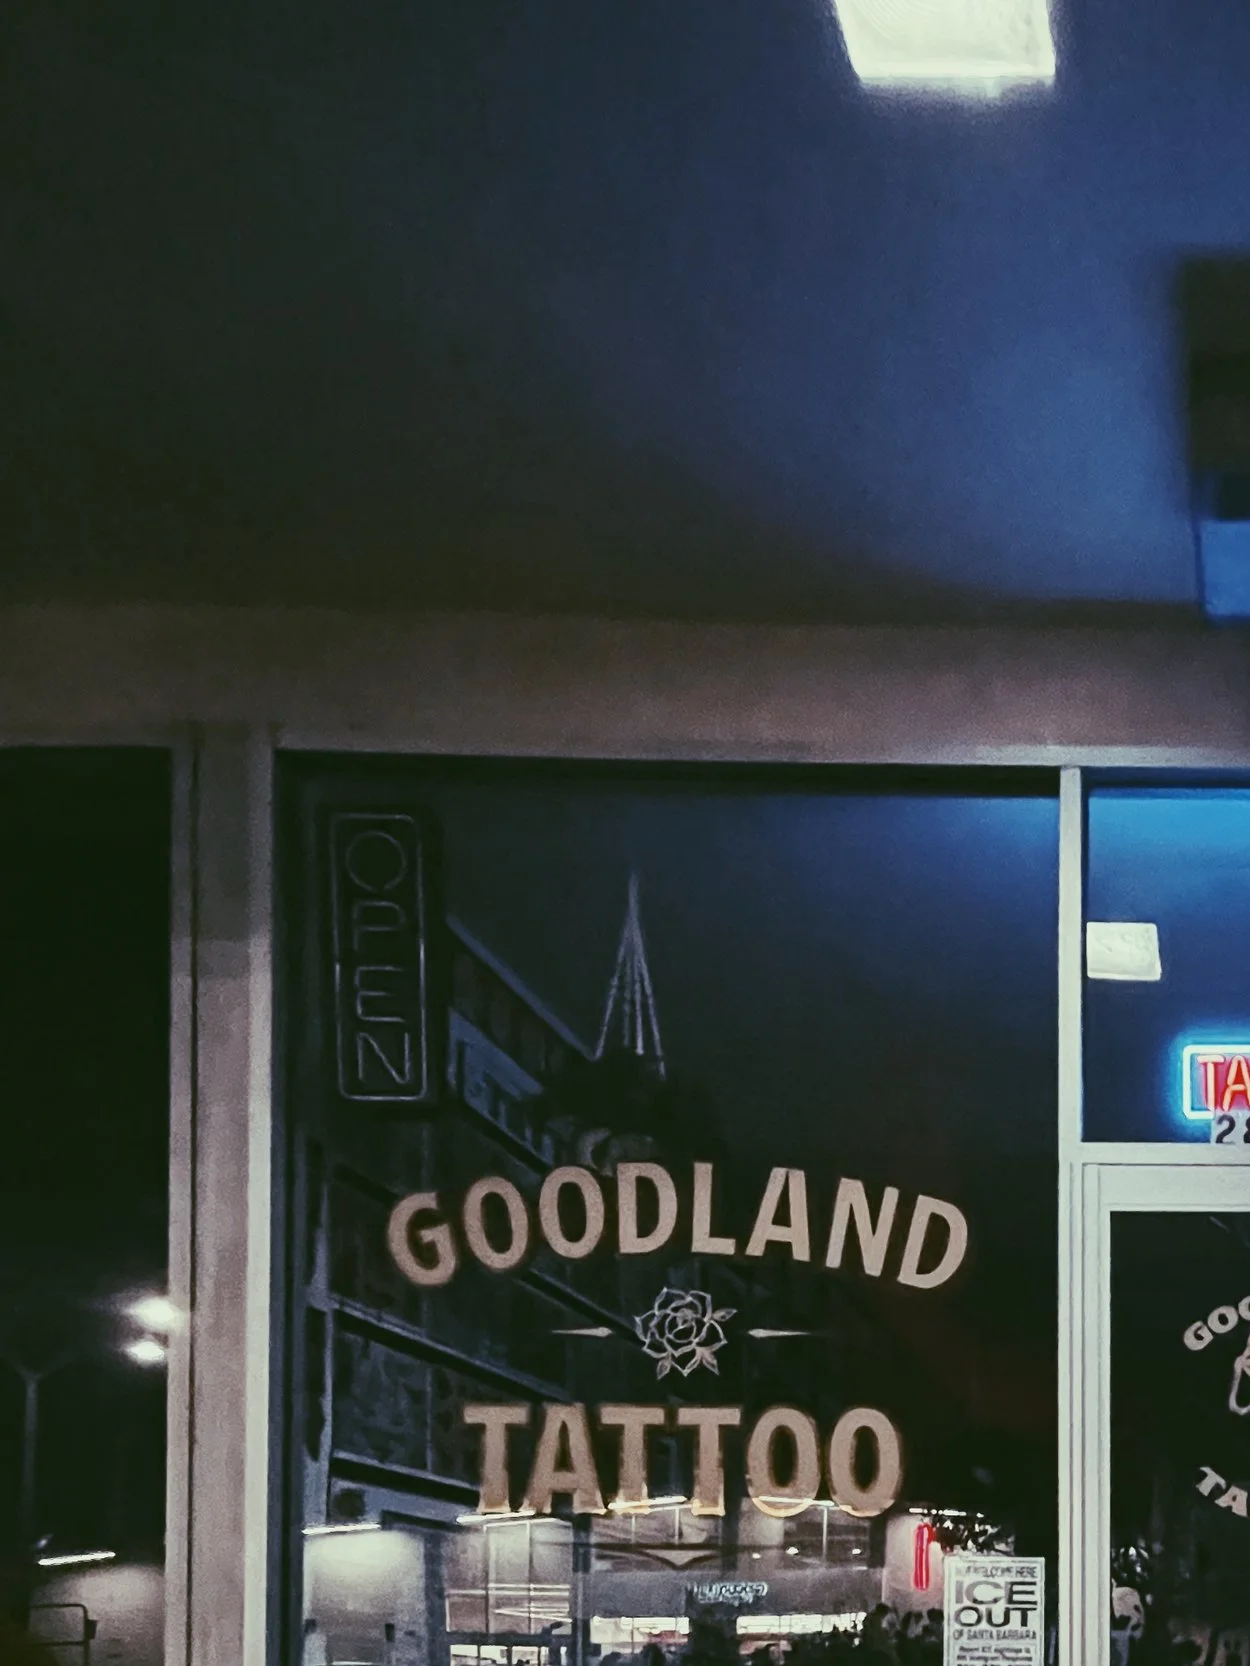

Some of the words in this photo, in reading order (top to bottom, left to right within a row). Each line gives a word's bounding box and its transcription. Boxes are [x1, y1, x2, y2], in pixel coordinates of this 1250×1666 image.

[345, 830, 413, 1086] OPEN
[387, 1162, 969, 1290] GOODLAND
[463, 1402, 903, 1518] TATTOO
[954, 1606, 1038, 1628] OUT
[955, 1580, 1038, 1605] ICE
[967, 1629, 993, 1641] SANTA
[995, 1629, 1037, 1641] BARBARA
